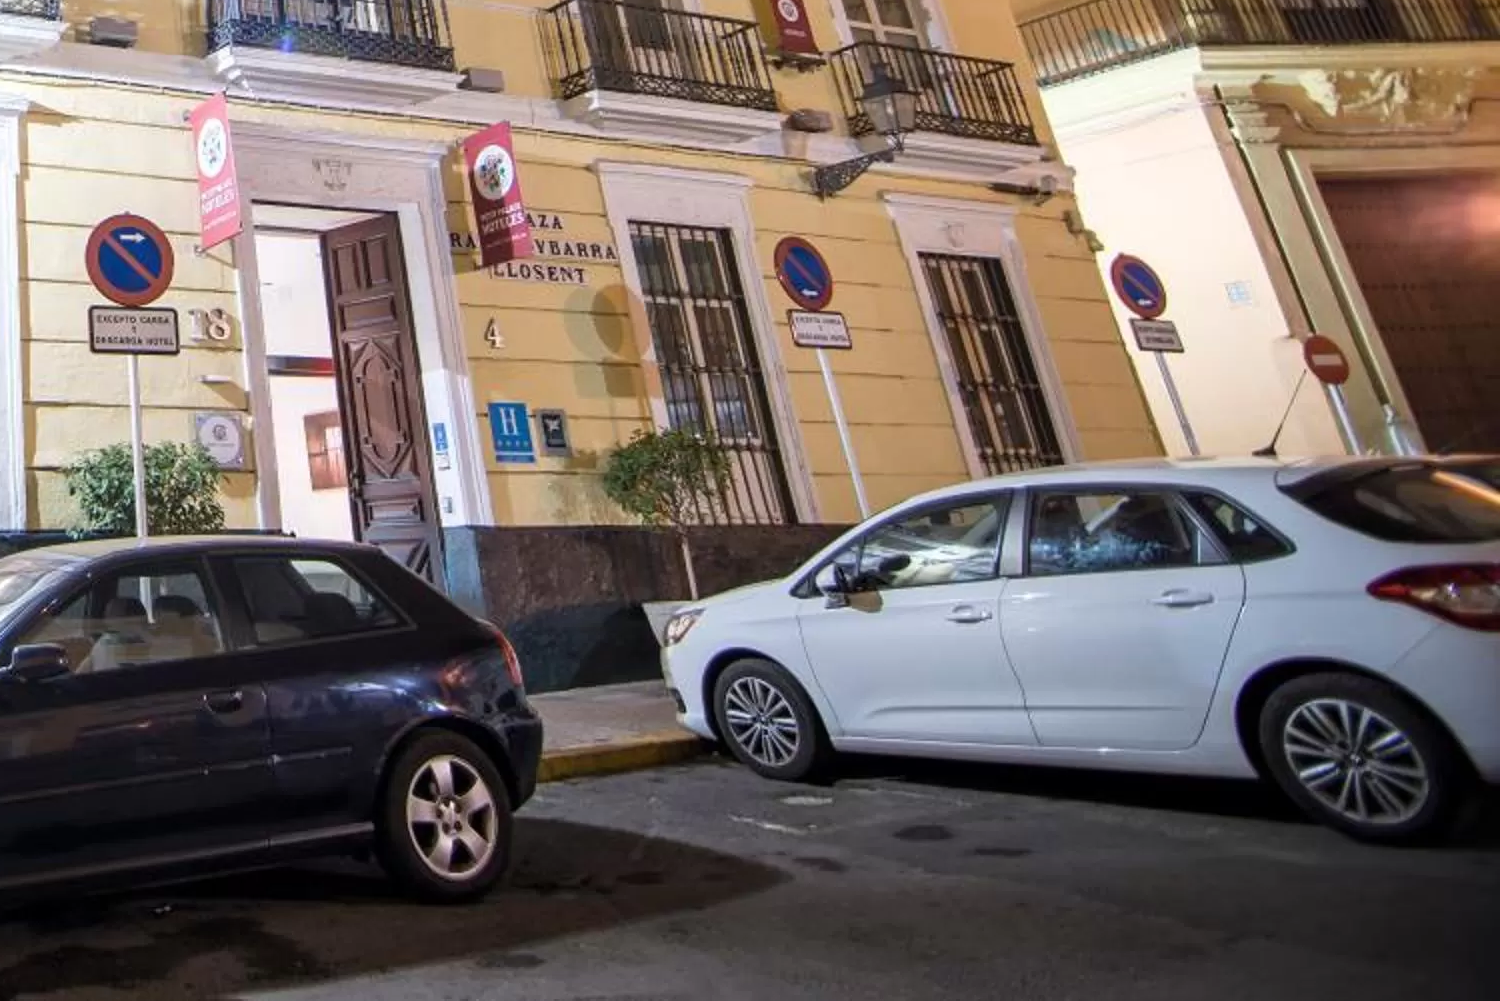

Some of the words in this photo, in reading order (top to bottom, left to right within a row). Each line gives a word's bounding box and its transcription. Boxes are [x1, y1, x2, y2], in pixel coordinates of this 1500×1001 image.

[533, 238, 617, 260] YBARRA
[187, 307, 232, 342] 18
[484, 315, 506, 350] 4
[499, 406, 520, 437] H
